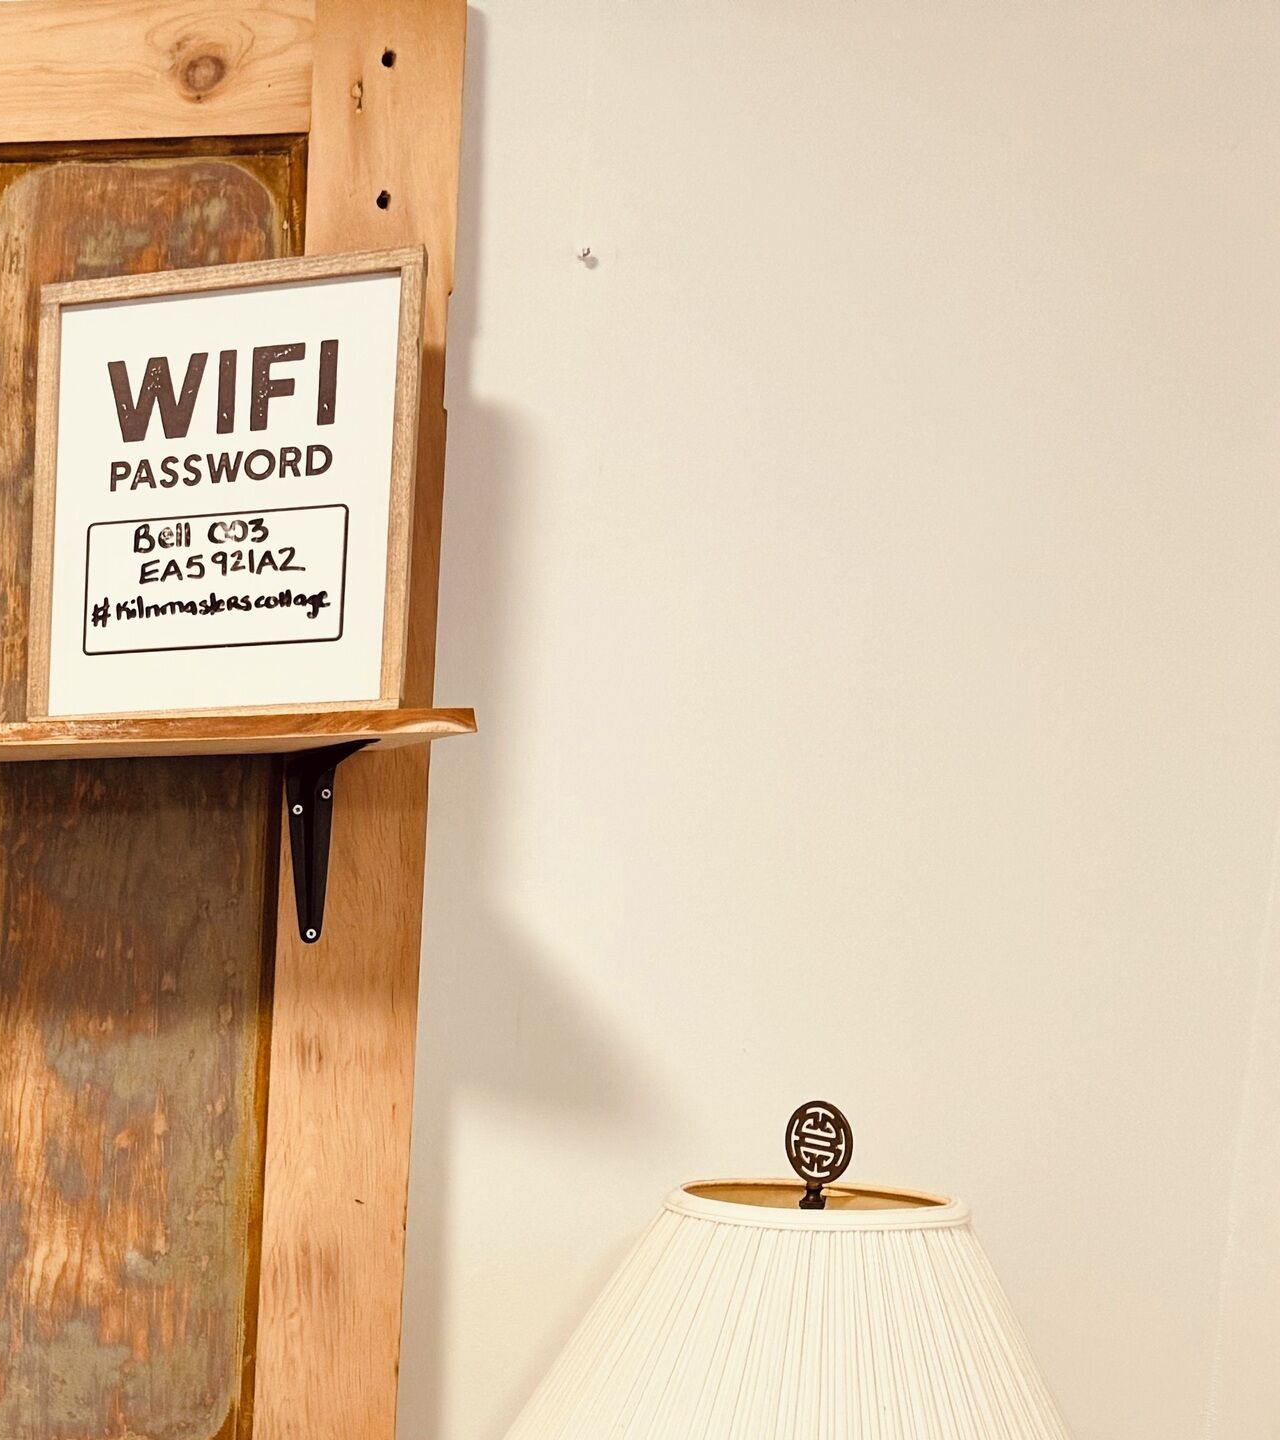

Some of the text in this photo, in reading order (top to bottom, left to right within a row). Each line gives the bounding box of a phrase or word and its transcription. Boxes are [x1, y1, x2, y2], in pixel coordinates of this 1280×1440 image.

[108, 339, 339, 442] WIFI
[110, 445, 333, 492] PASSWORD
[134, 522, 191, 553] Bell
